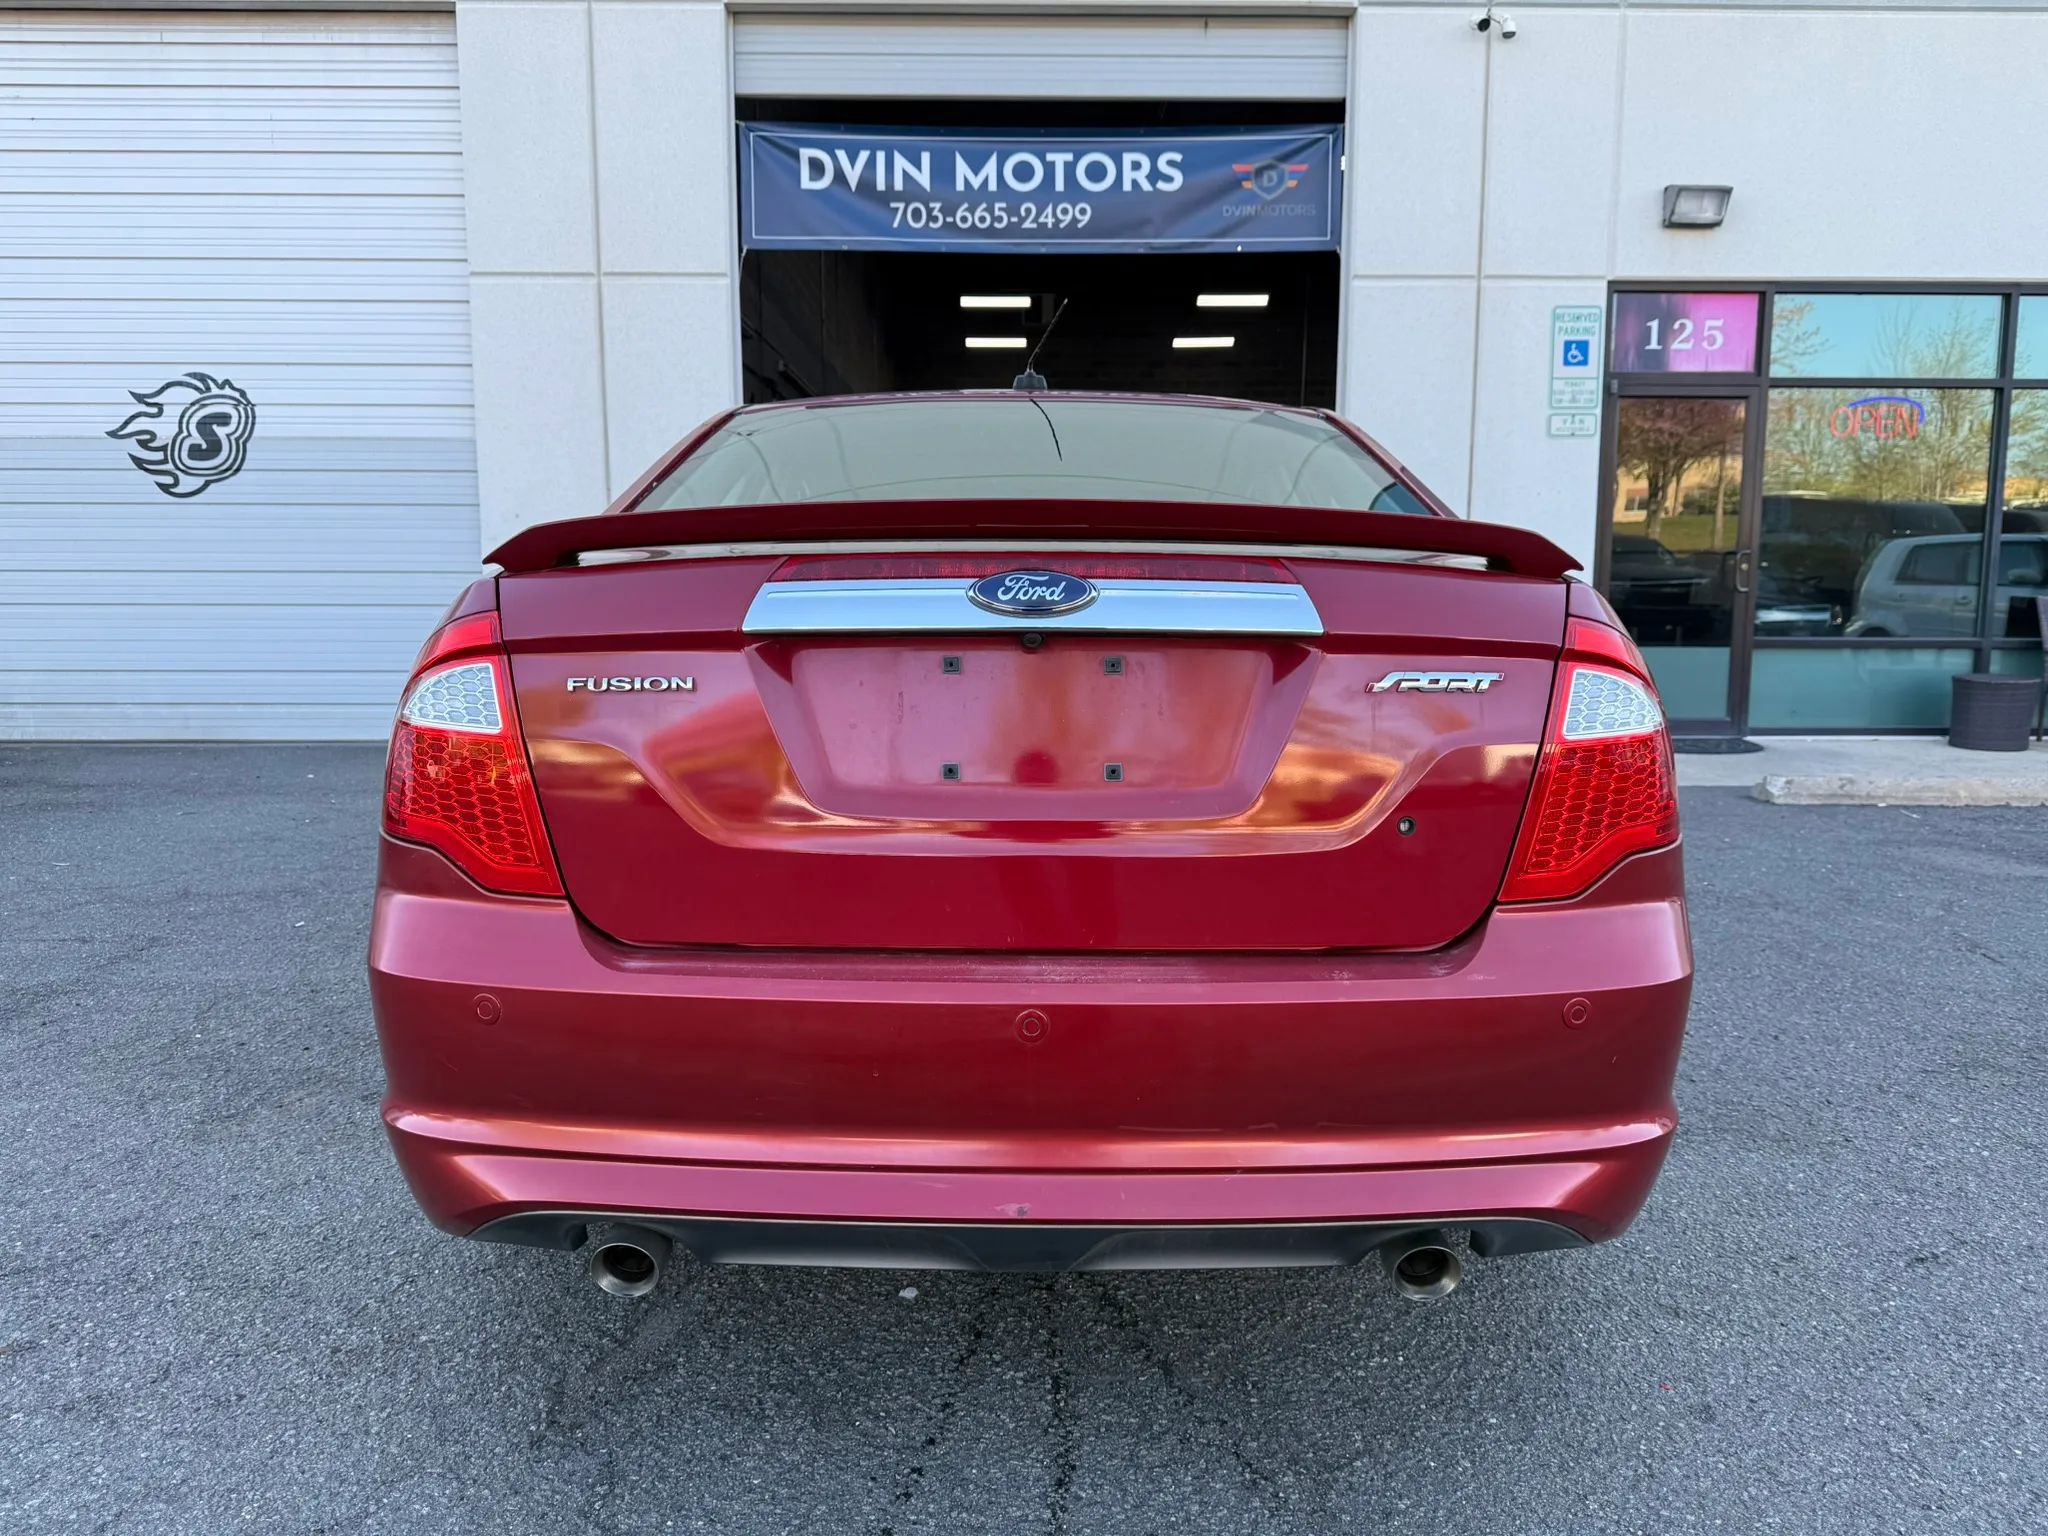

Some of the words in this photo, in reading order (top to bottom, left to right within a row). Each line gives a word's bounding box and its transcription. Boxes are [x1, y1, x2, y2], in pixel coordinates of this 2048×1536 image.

[799, 147, 931, 192] DVIN
[955, 151, 1184, 193] MOTORS
[1263, 170, 1278, 187] D
[889, 202, 1093, 230] 703-665-2499
[1555, 312, 1600, 323] RESERVED
[1557, 325, 1597, 337] PARKING
[1644, 318, 1725, 350] 125
[1830, 405, 1920, 439] OPEN
[997, 574, 1067, 601] Ford
[566, 676, 695, 692] FUSION
[1365, 671, 1505, 693] SPORT
